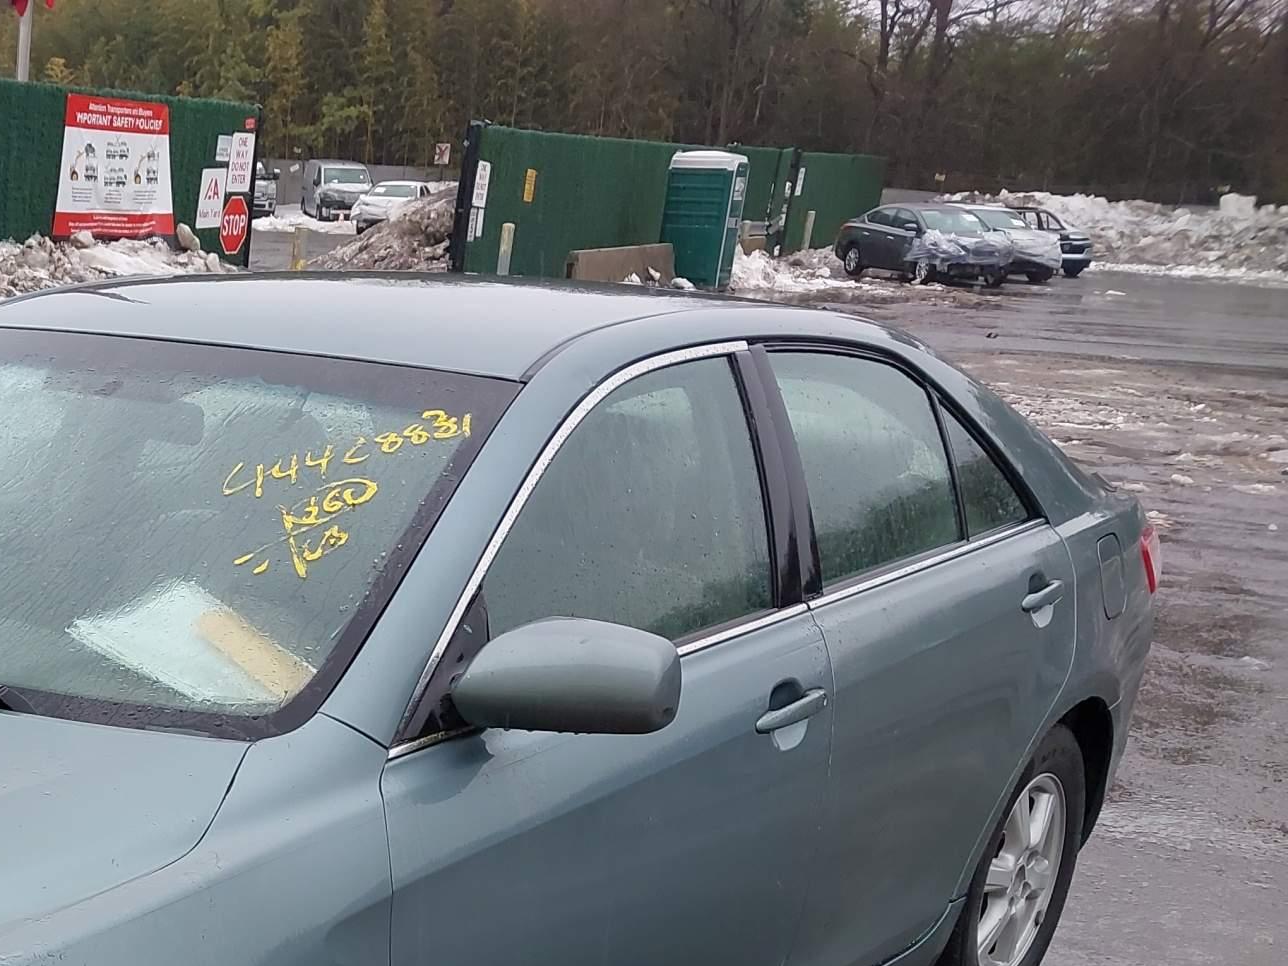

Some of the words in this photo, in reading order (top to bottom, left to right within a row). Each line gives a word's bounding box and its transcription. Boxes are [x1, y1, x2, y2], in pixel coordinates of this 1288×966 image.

[112, 115, 136, 129] SAFETY
[235, 150, 249, 159] WAY
[231, 174, 246, 185] ENTER
[223, 213, 246, 237] STOP
